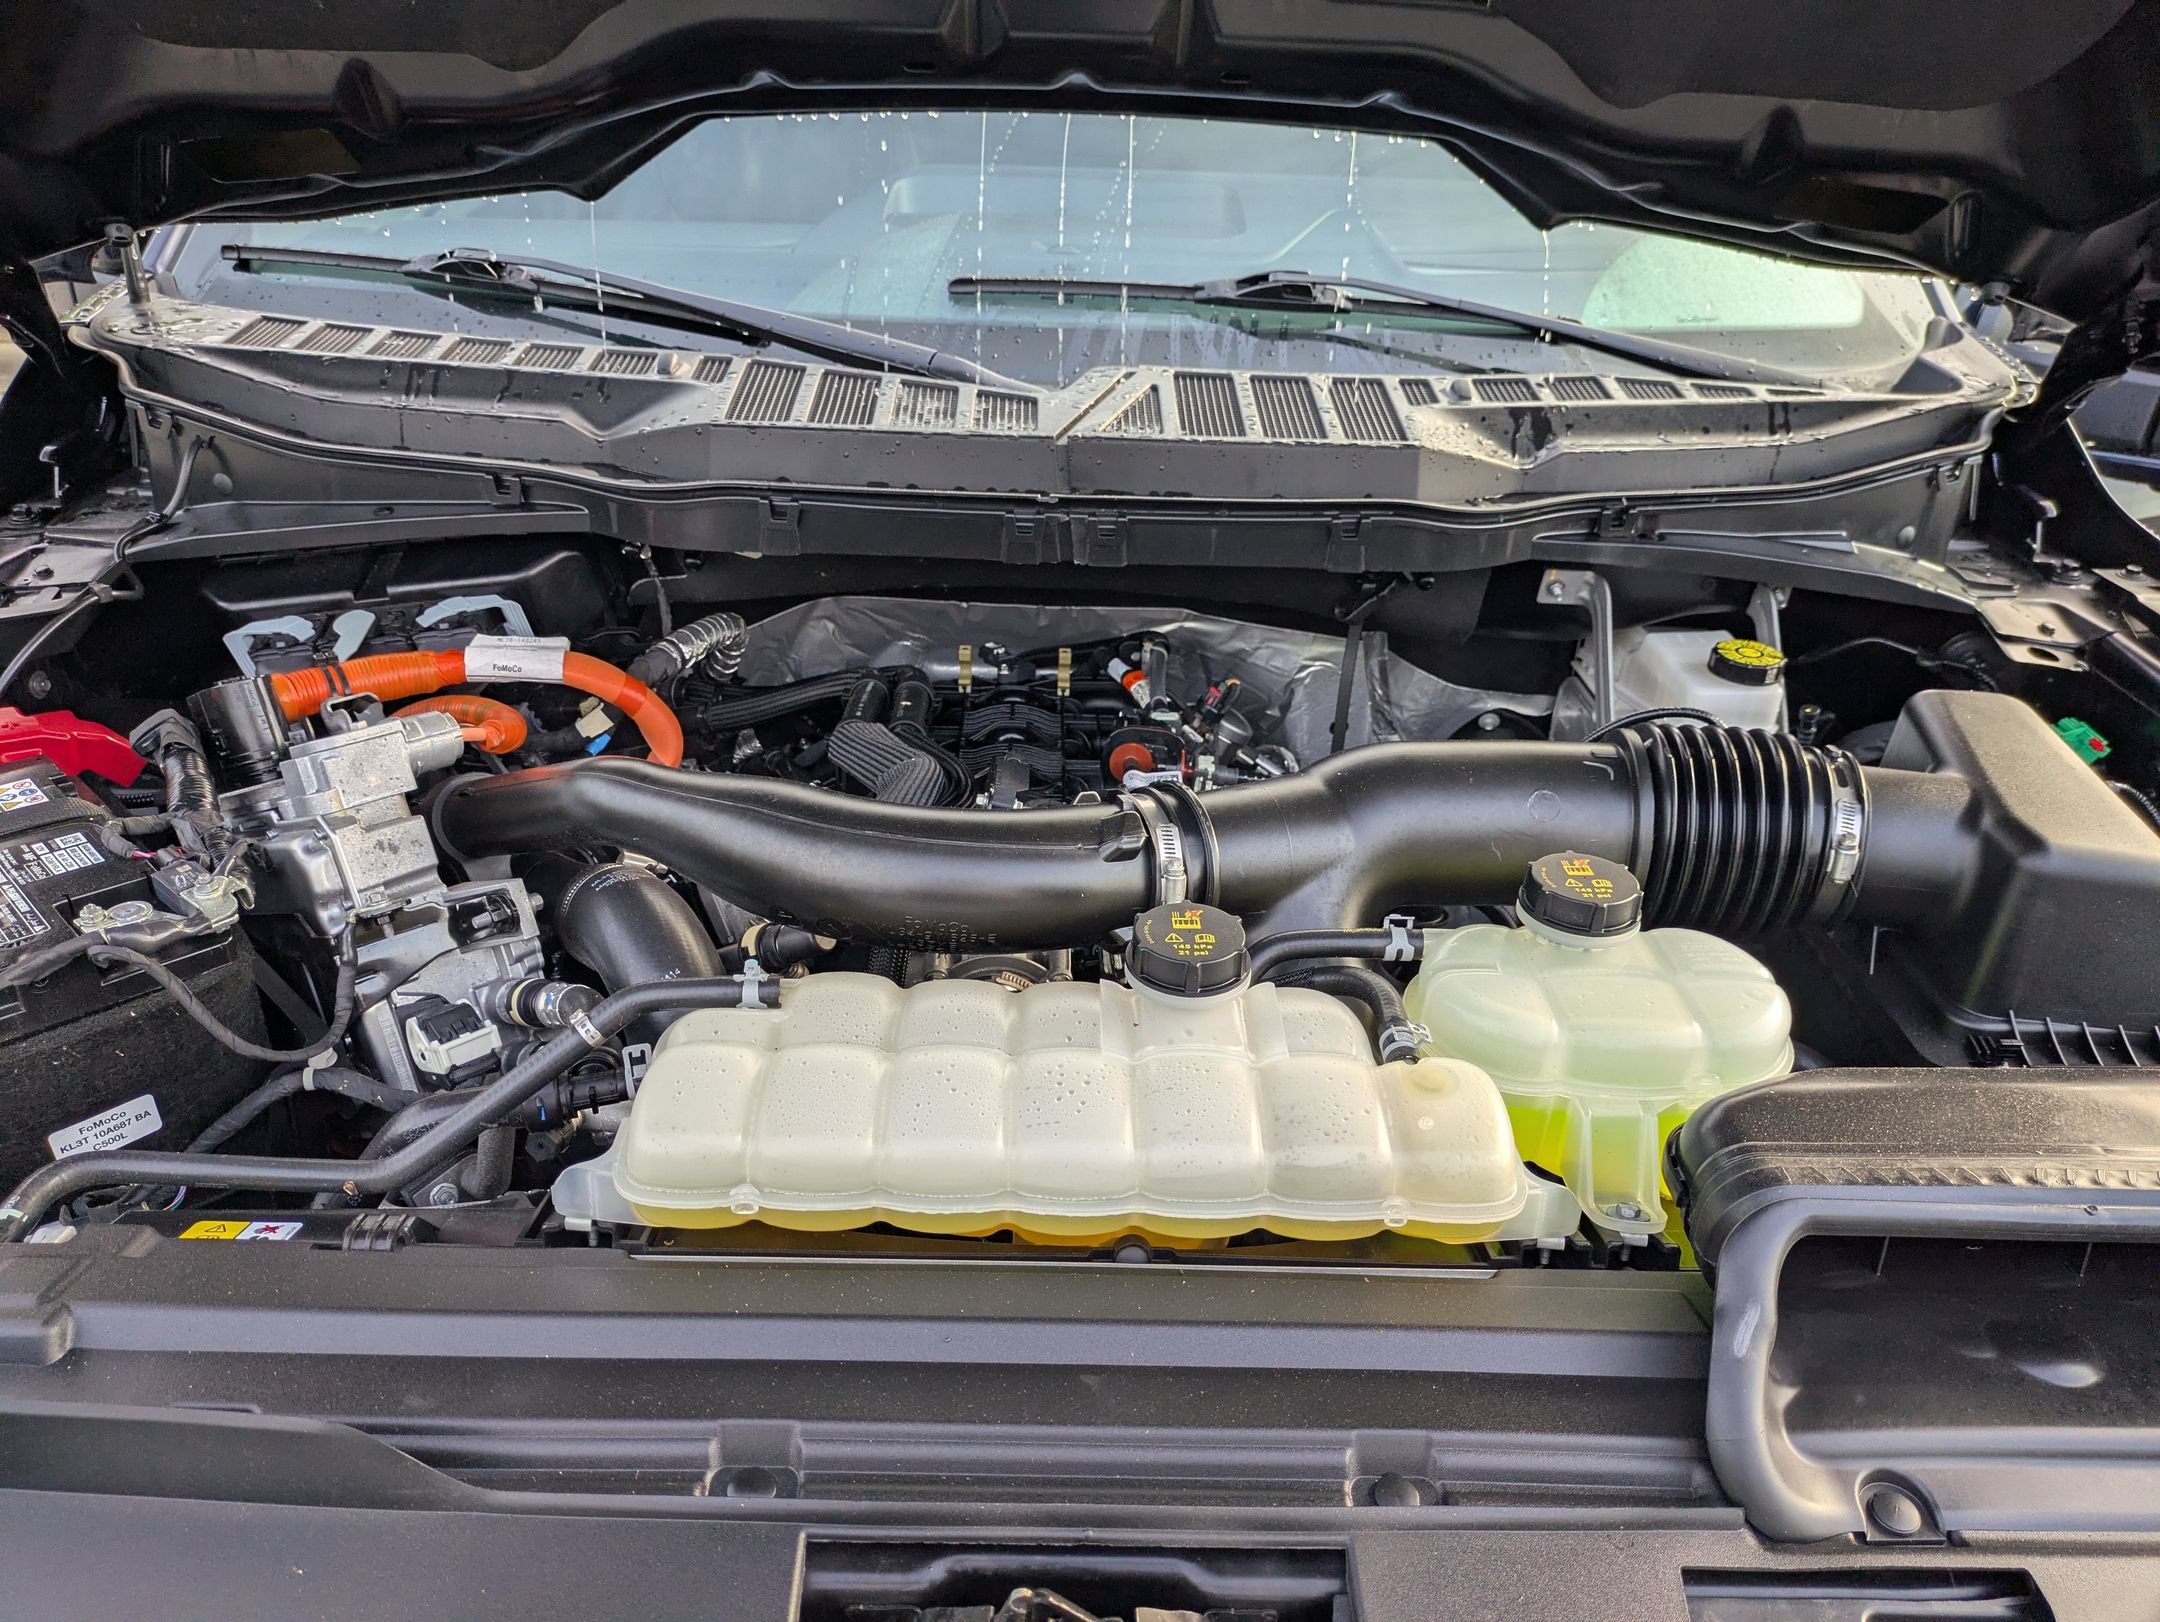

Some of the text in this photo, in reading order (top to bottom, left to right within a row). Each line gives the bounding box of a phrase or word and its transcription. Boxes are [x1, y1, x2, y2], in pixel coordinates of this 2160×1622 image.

[492, 664, 522, 673] FoMoCo
[60, 1110, 152, 1154] KL3T 10A687 BA
[79, 1111, 127, 1135] FoMoCo
[92, 1132, 128, 1151] C500L
